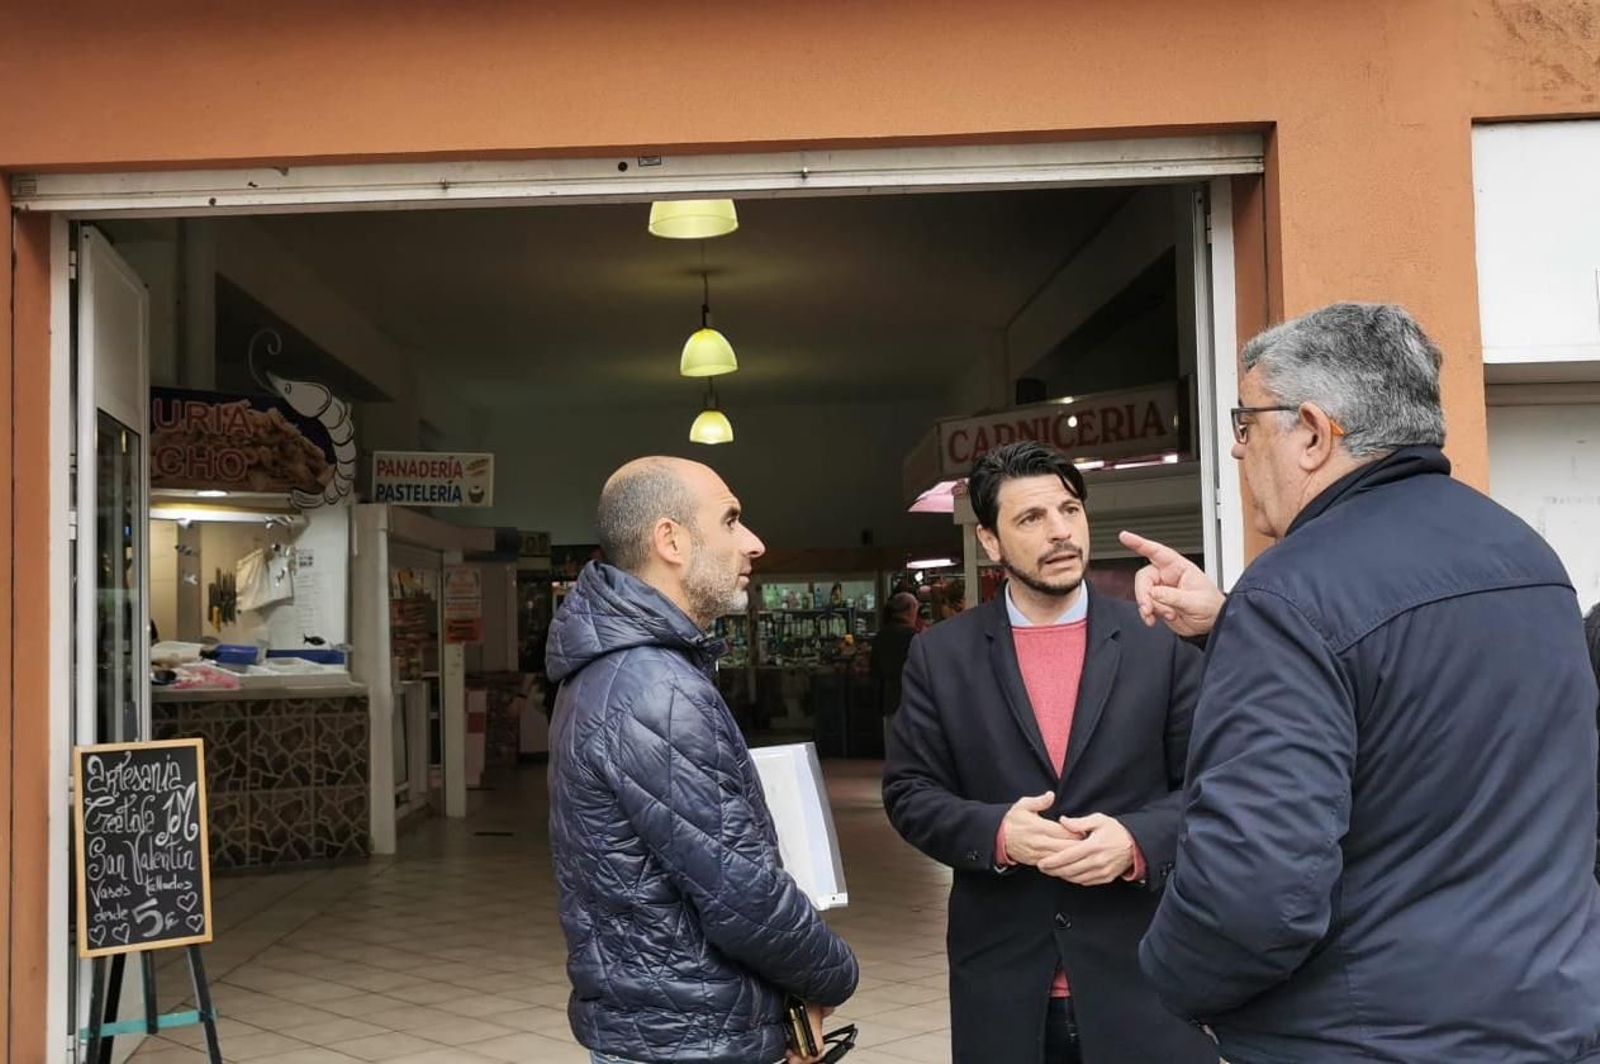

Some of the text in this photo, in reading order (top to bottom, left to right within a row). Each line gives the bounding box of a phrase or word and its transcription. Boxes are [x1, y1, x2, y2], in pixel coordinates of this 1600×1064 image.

[376, 456, 463, 478] PANADERÍA
[376, 480, 463, 503] PASTELERÍA
[87, 837, 128, 881] San
[93, 903, 129, 923] desde
